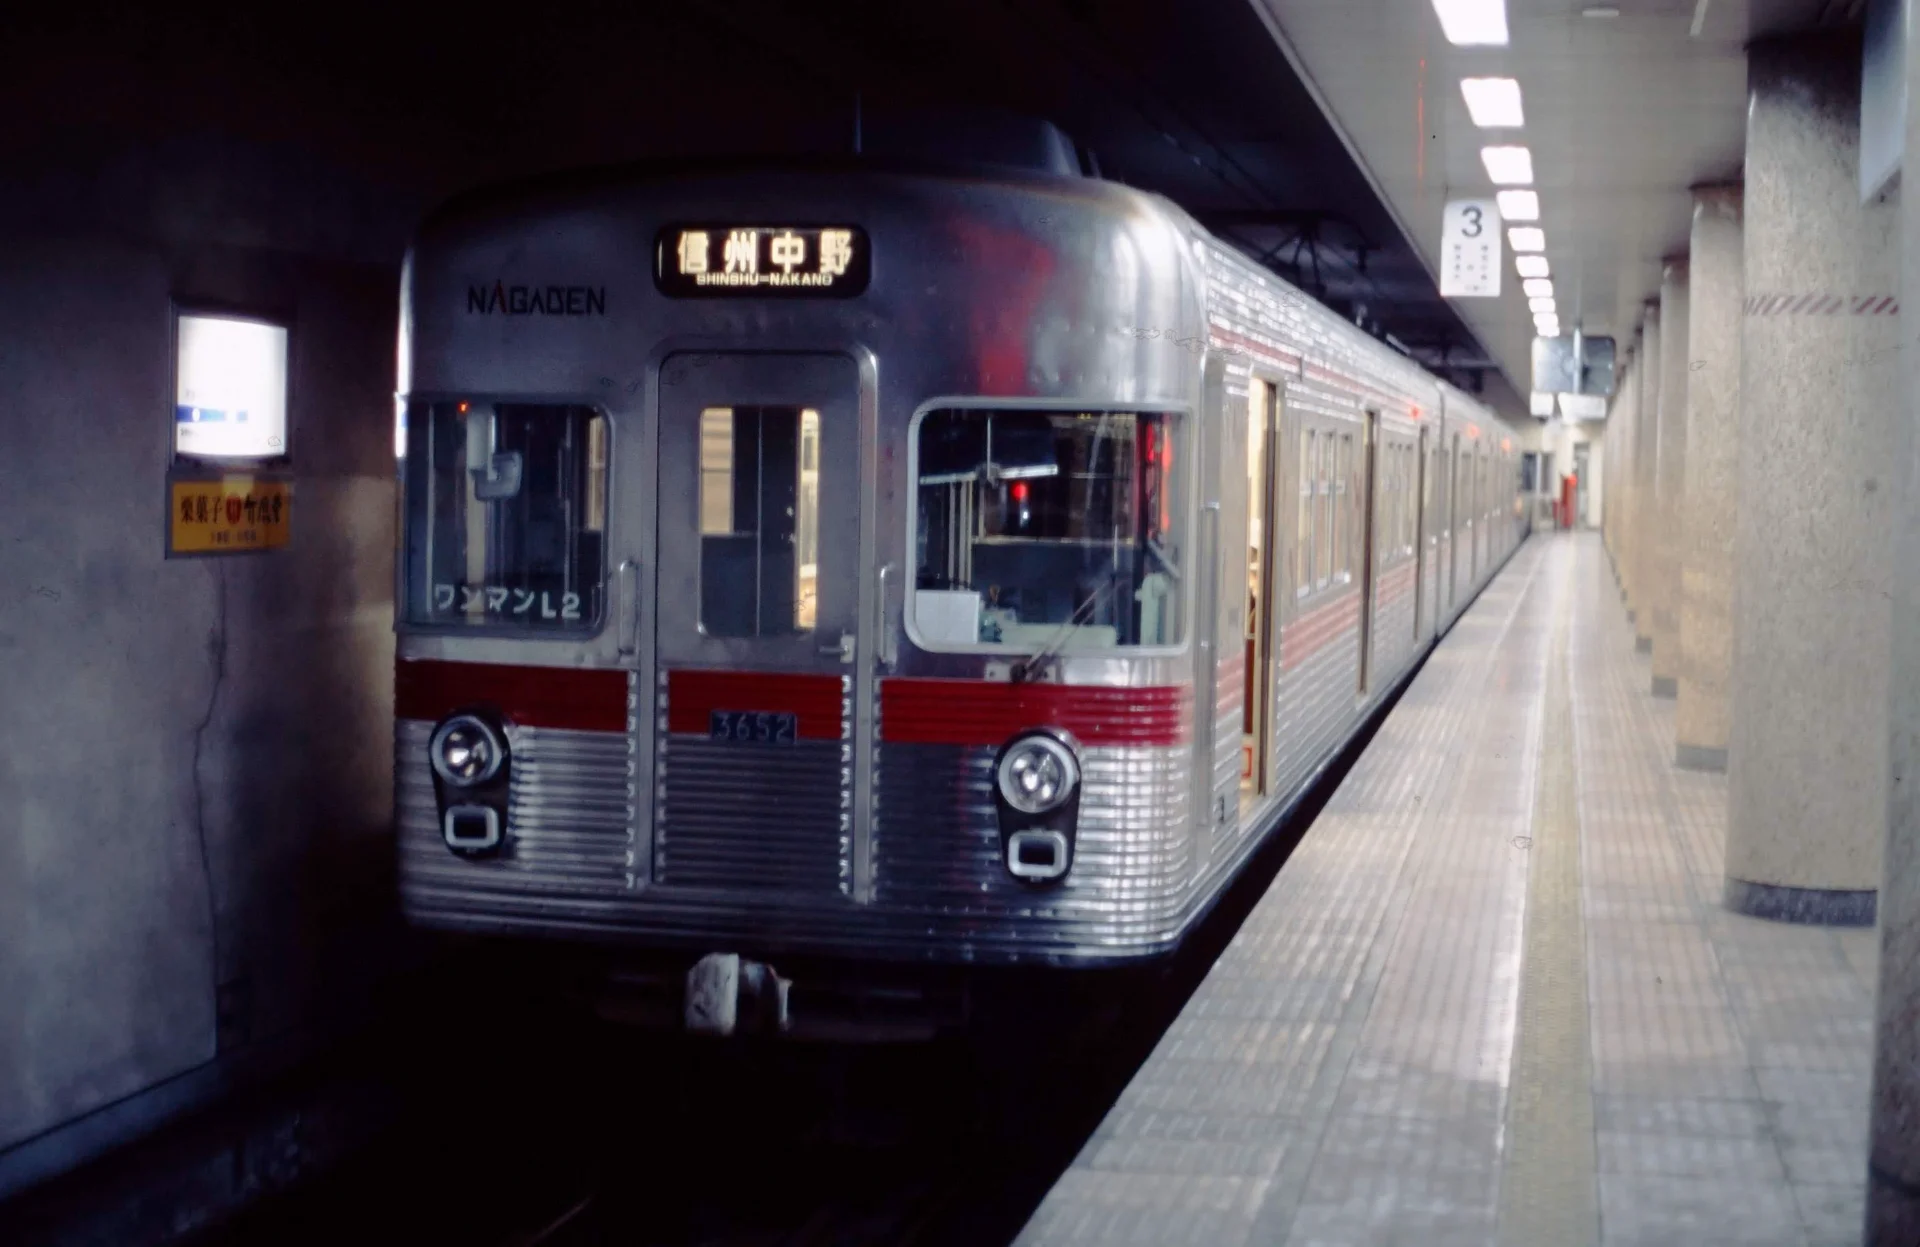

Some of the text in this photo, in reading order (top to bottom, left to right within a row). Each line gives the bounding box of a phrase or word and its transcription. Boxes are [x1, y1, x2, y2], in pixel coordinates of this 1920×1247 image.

[1461, 205, 1483, 238] 3
[677, 230, 852, 275] 信州中野
[467, 279, 606, 315] NAGADEN
[714, 712, 794, 743] 3652
